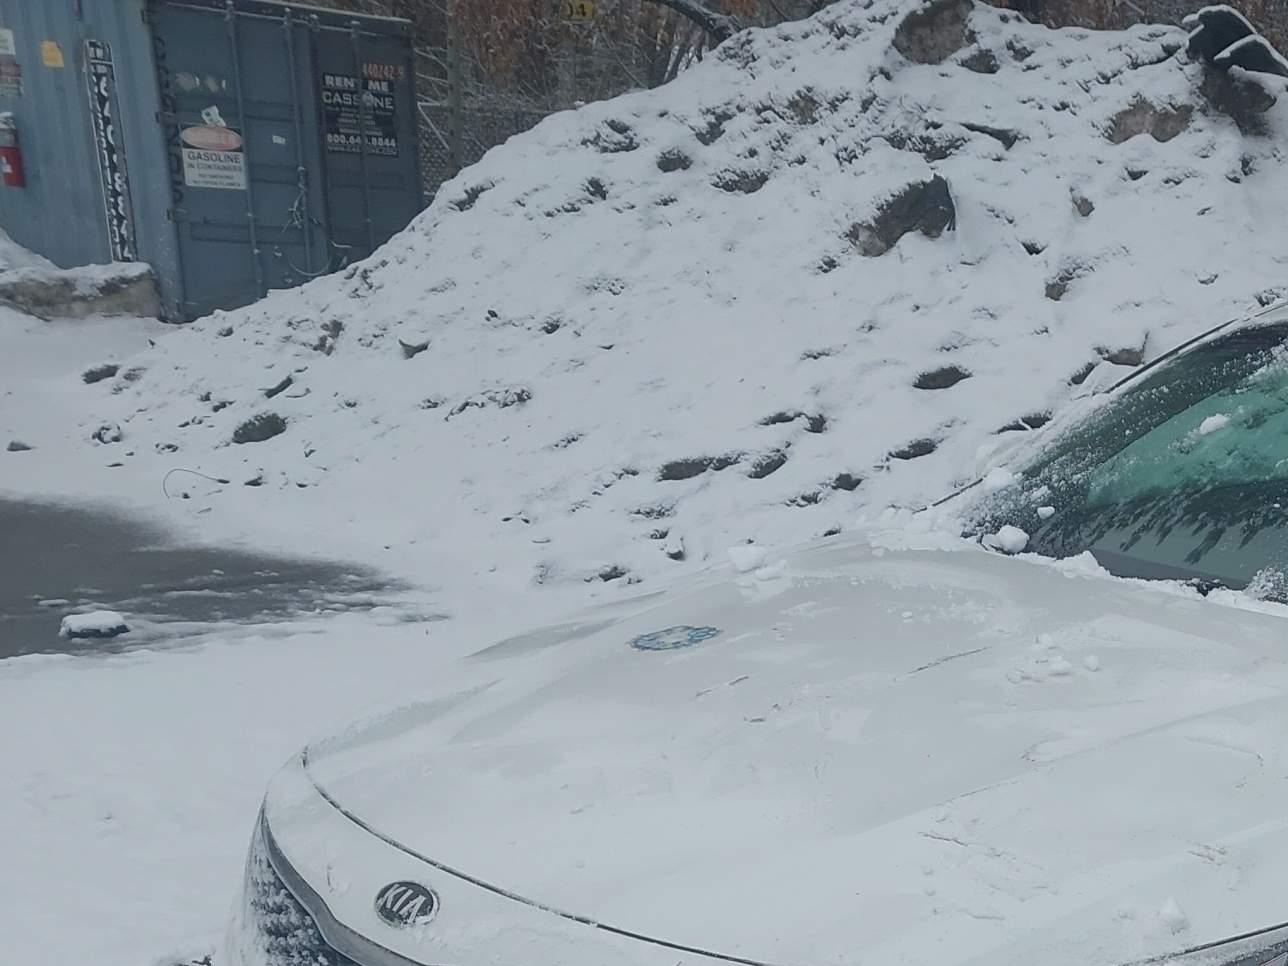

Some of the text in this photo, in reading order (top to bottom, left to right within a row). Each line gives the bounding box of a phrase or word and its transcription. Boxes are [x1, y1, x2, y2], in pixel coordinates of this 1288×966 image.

[324, 75, 390, 92] REN ME
[187, 151, 241, 164] GASOLINE
